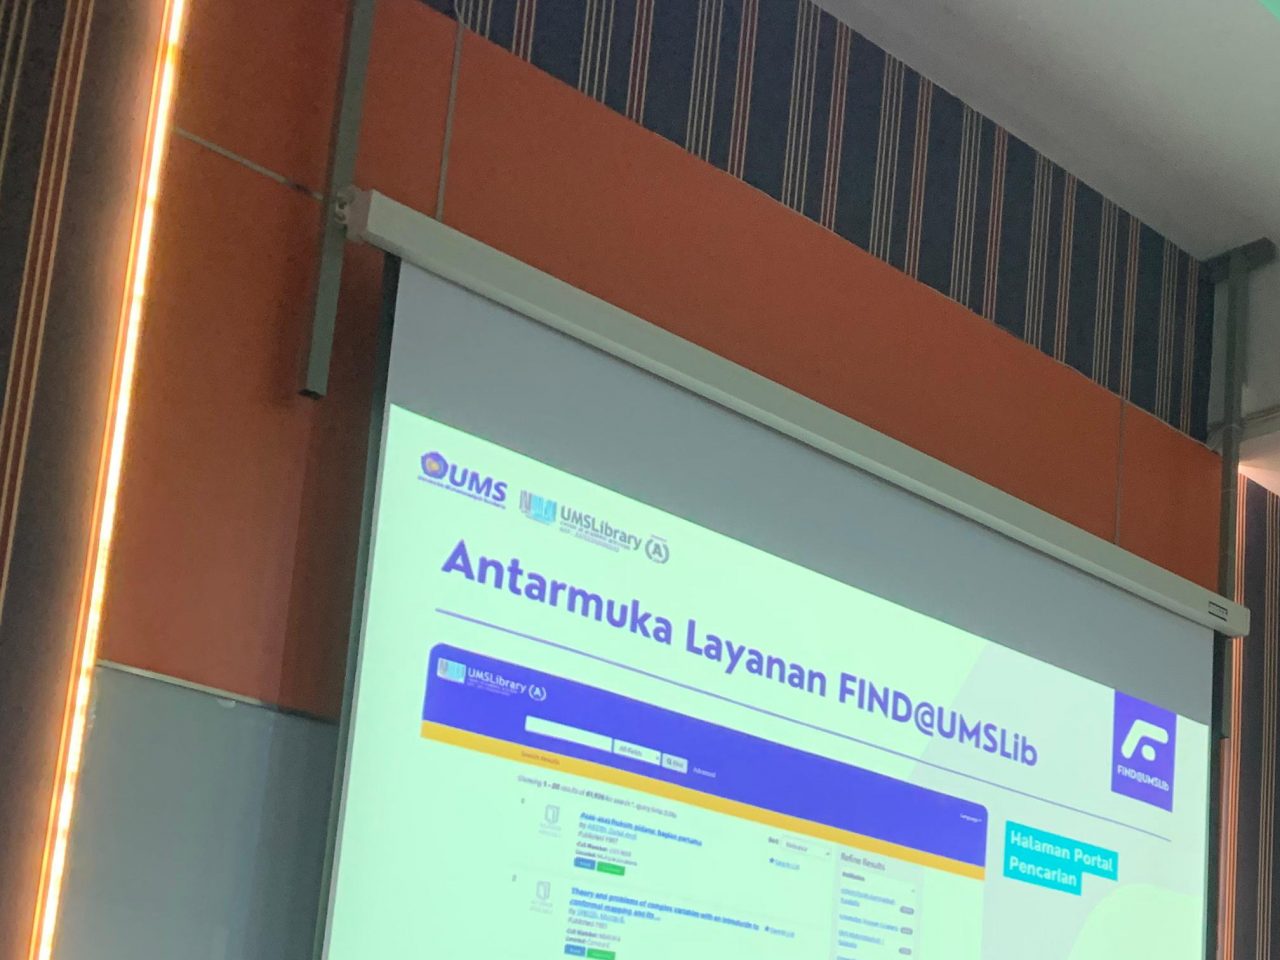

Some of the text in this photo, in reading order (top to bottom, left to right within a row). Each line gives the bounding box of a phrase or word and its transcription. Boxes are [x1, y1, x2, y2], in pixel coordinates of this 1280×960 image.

[449, 464, 507, 502] UMS
[561, 505, 642, 551] UMSLibrary
[441, 539, 1038, 767] Antarmuka Layanan FIND@UMSLib
[467, 667, 527, 695] UMSLibrary
[1117, 764, 1170, 792] FIND@UMSLib
[1011, 830, 1113, 872] Halaman Portal
[1009, 856, 1077, 887] Pencarian
